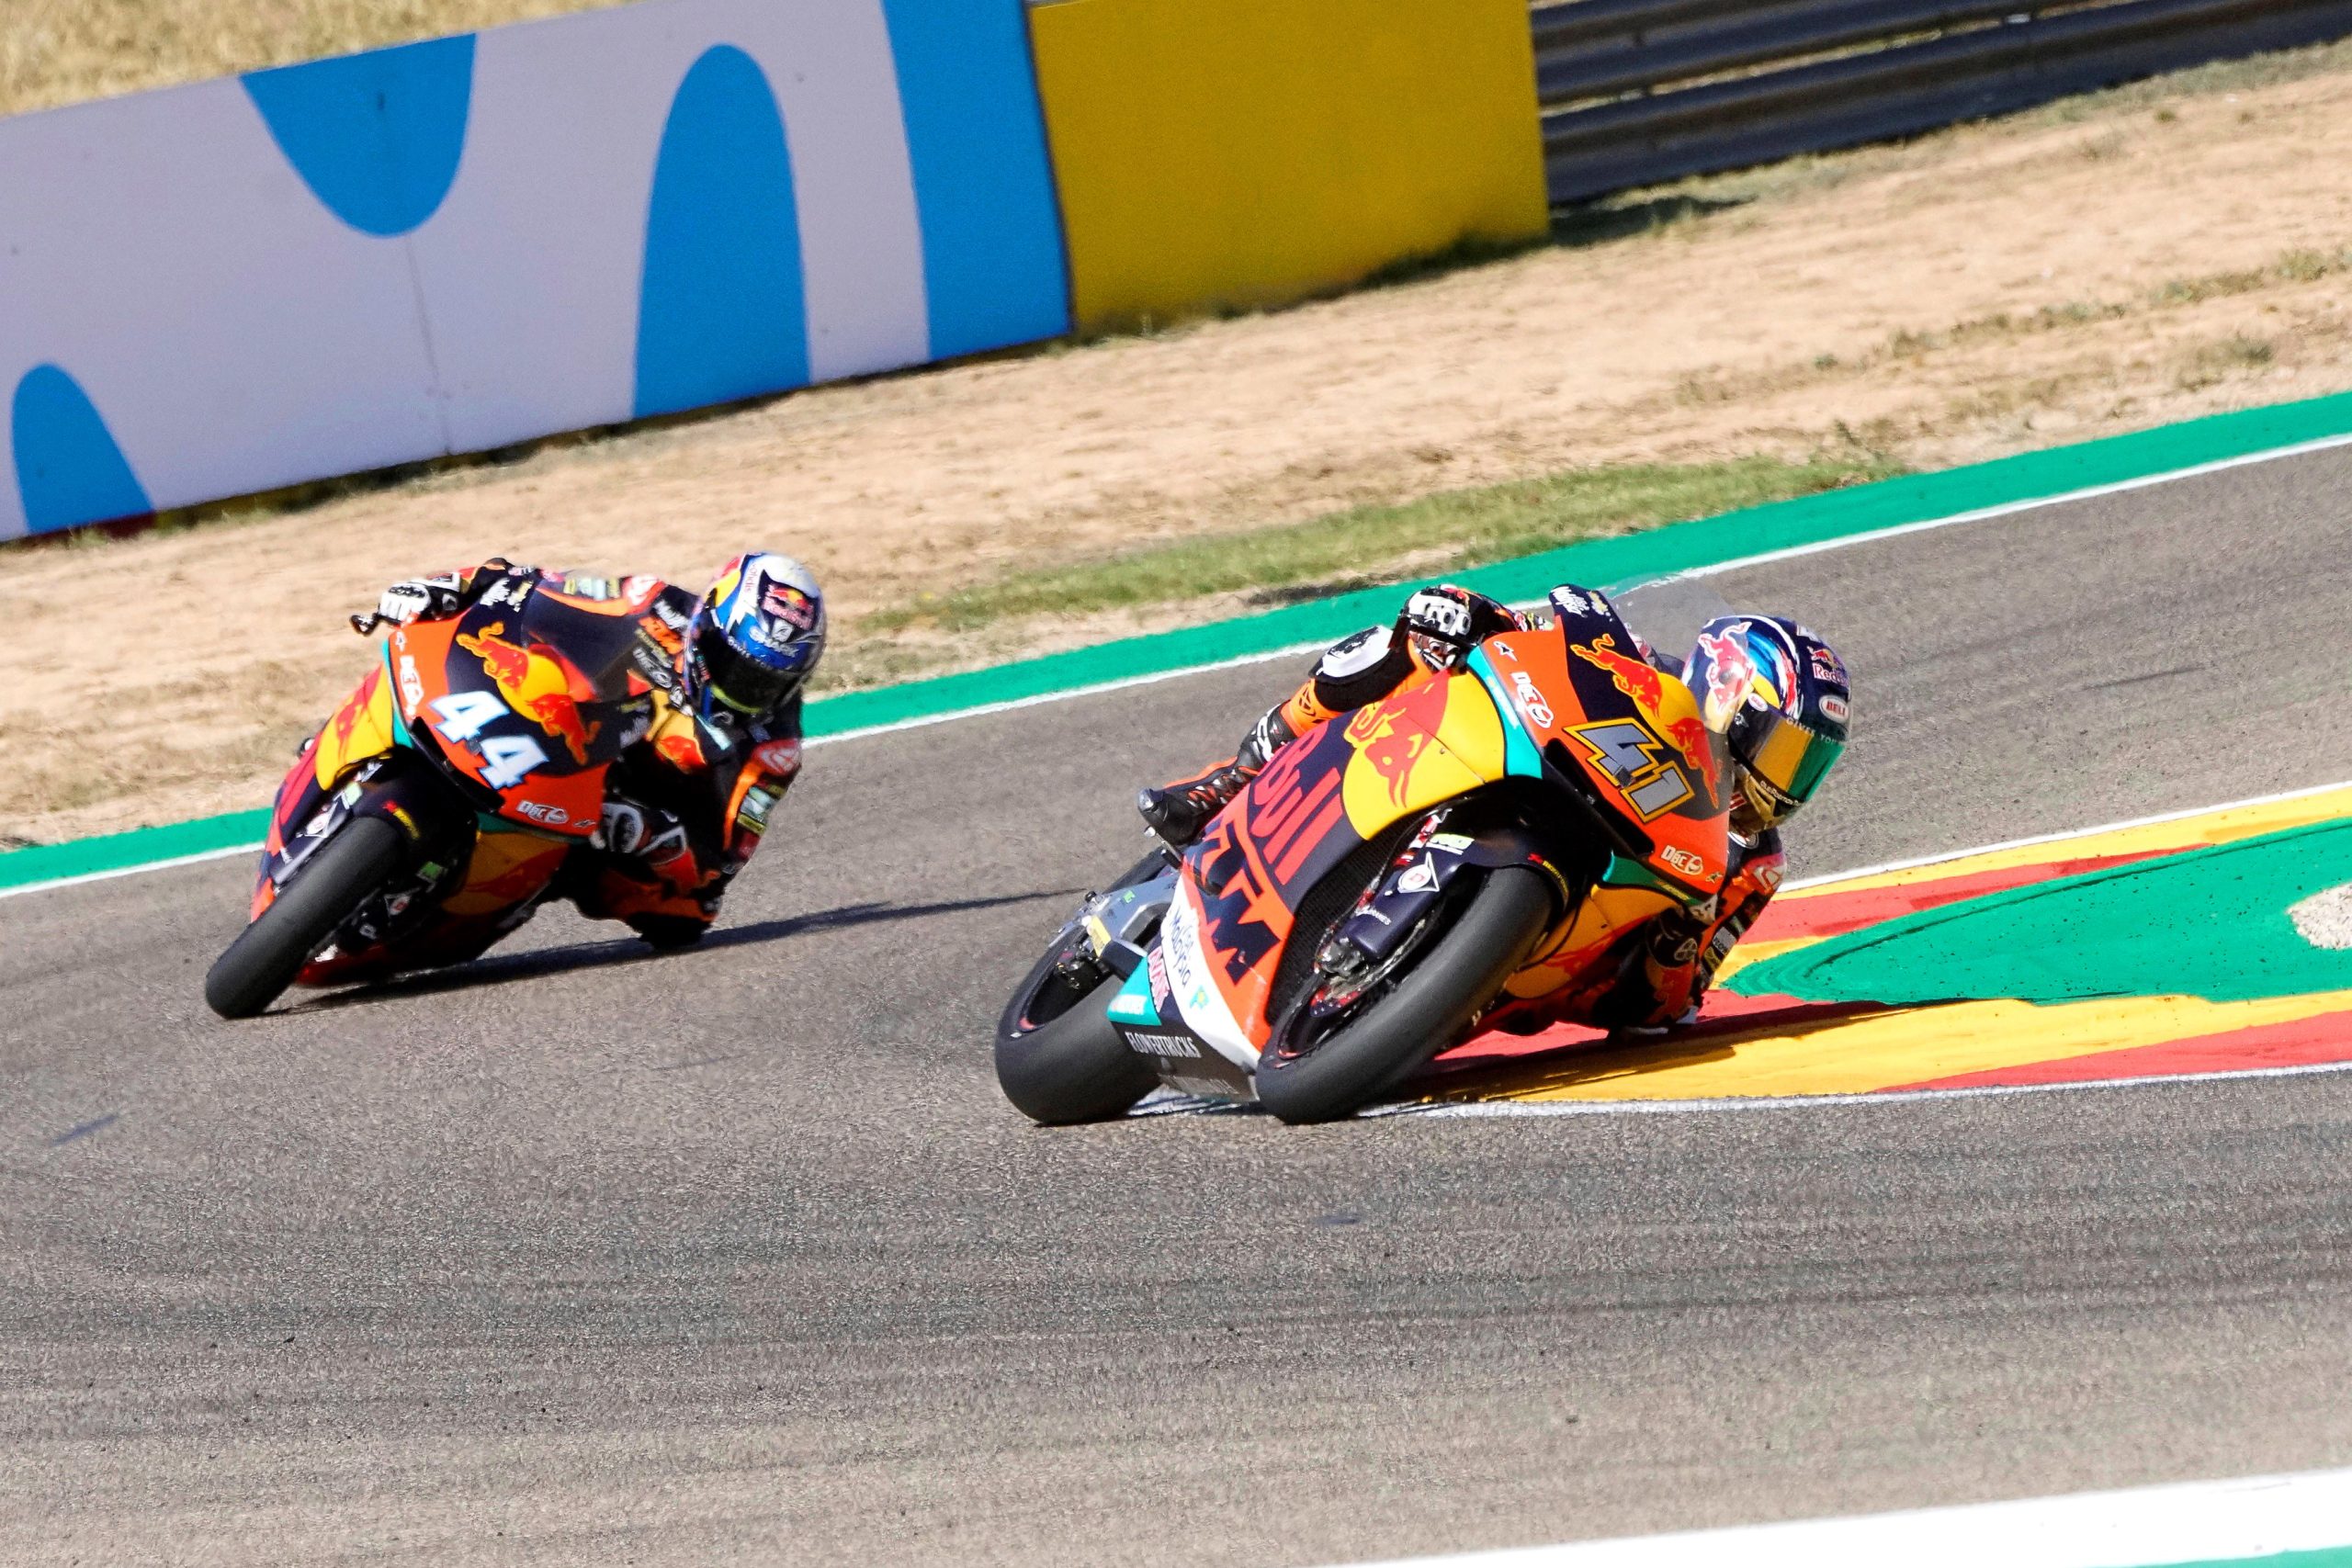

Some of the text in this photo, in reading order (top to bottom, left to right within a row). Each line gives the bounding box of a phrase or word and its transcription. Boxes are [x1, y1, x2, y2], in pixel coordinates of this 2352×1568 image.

[429, 691, 550, 792] 44
[1564, 718, 1694, 823] 41
[1250, 720, 1345, 886] Bull
[1125, 1031, 1202, 1058] FLOWERTRUCKS
